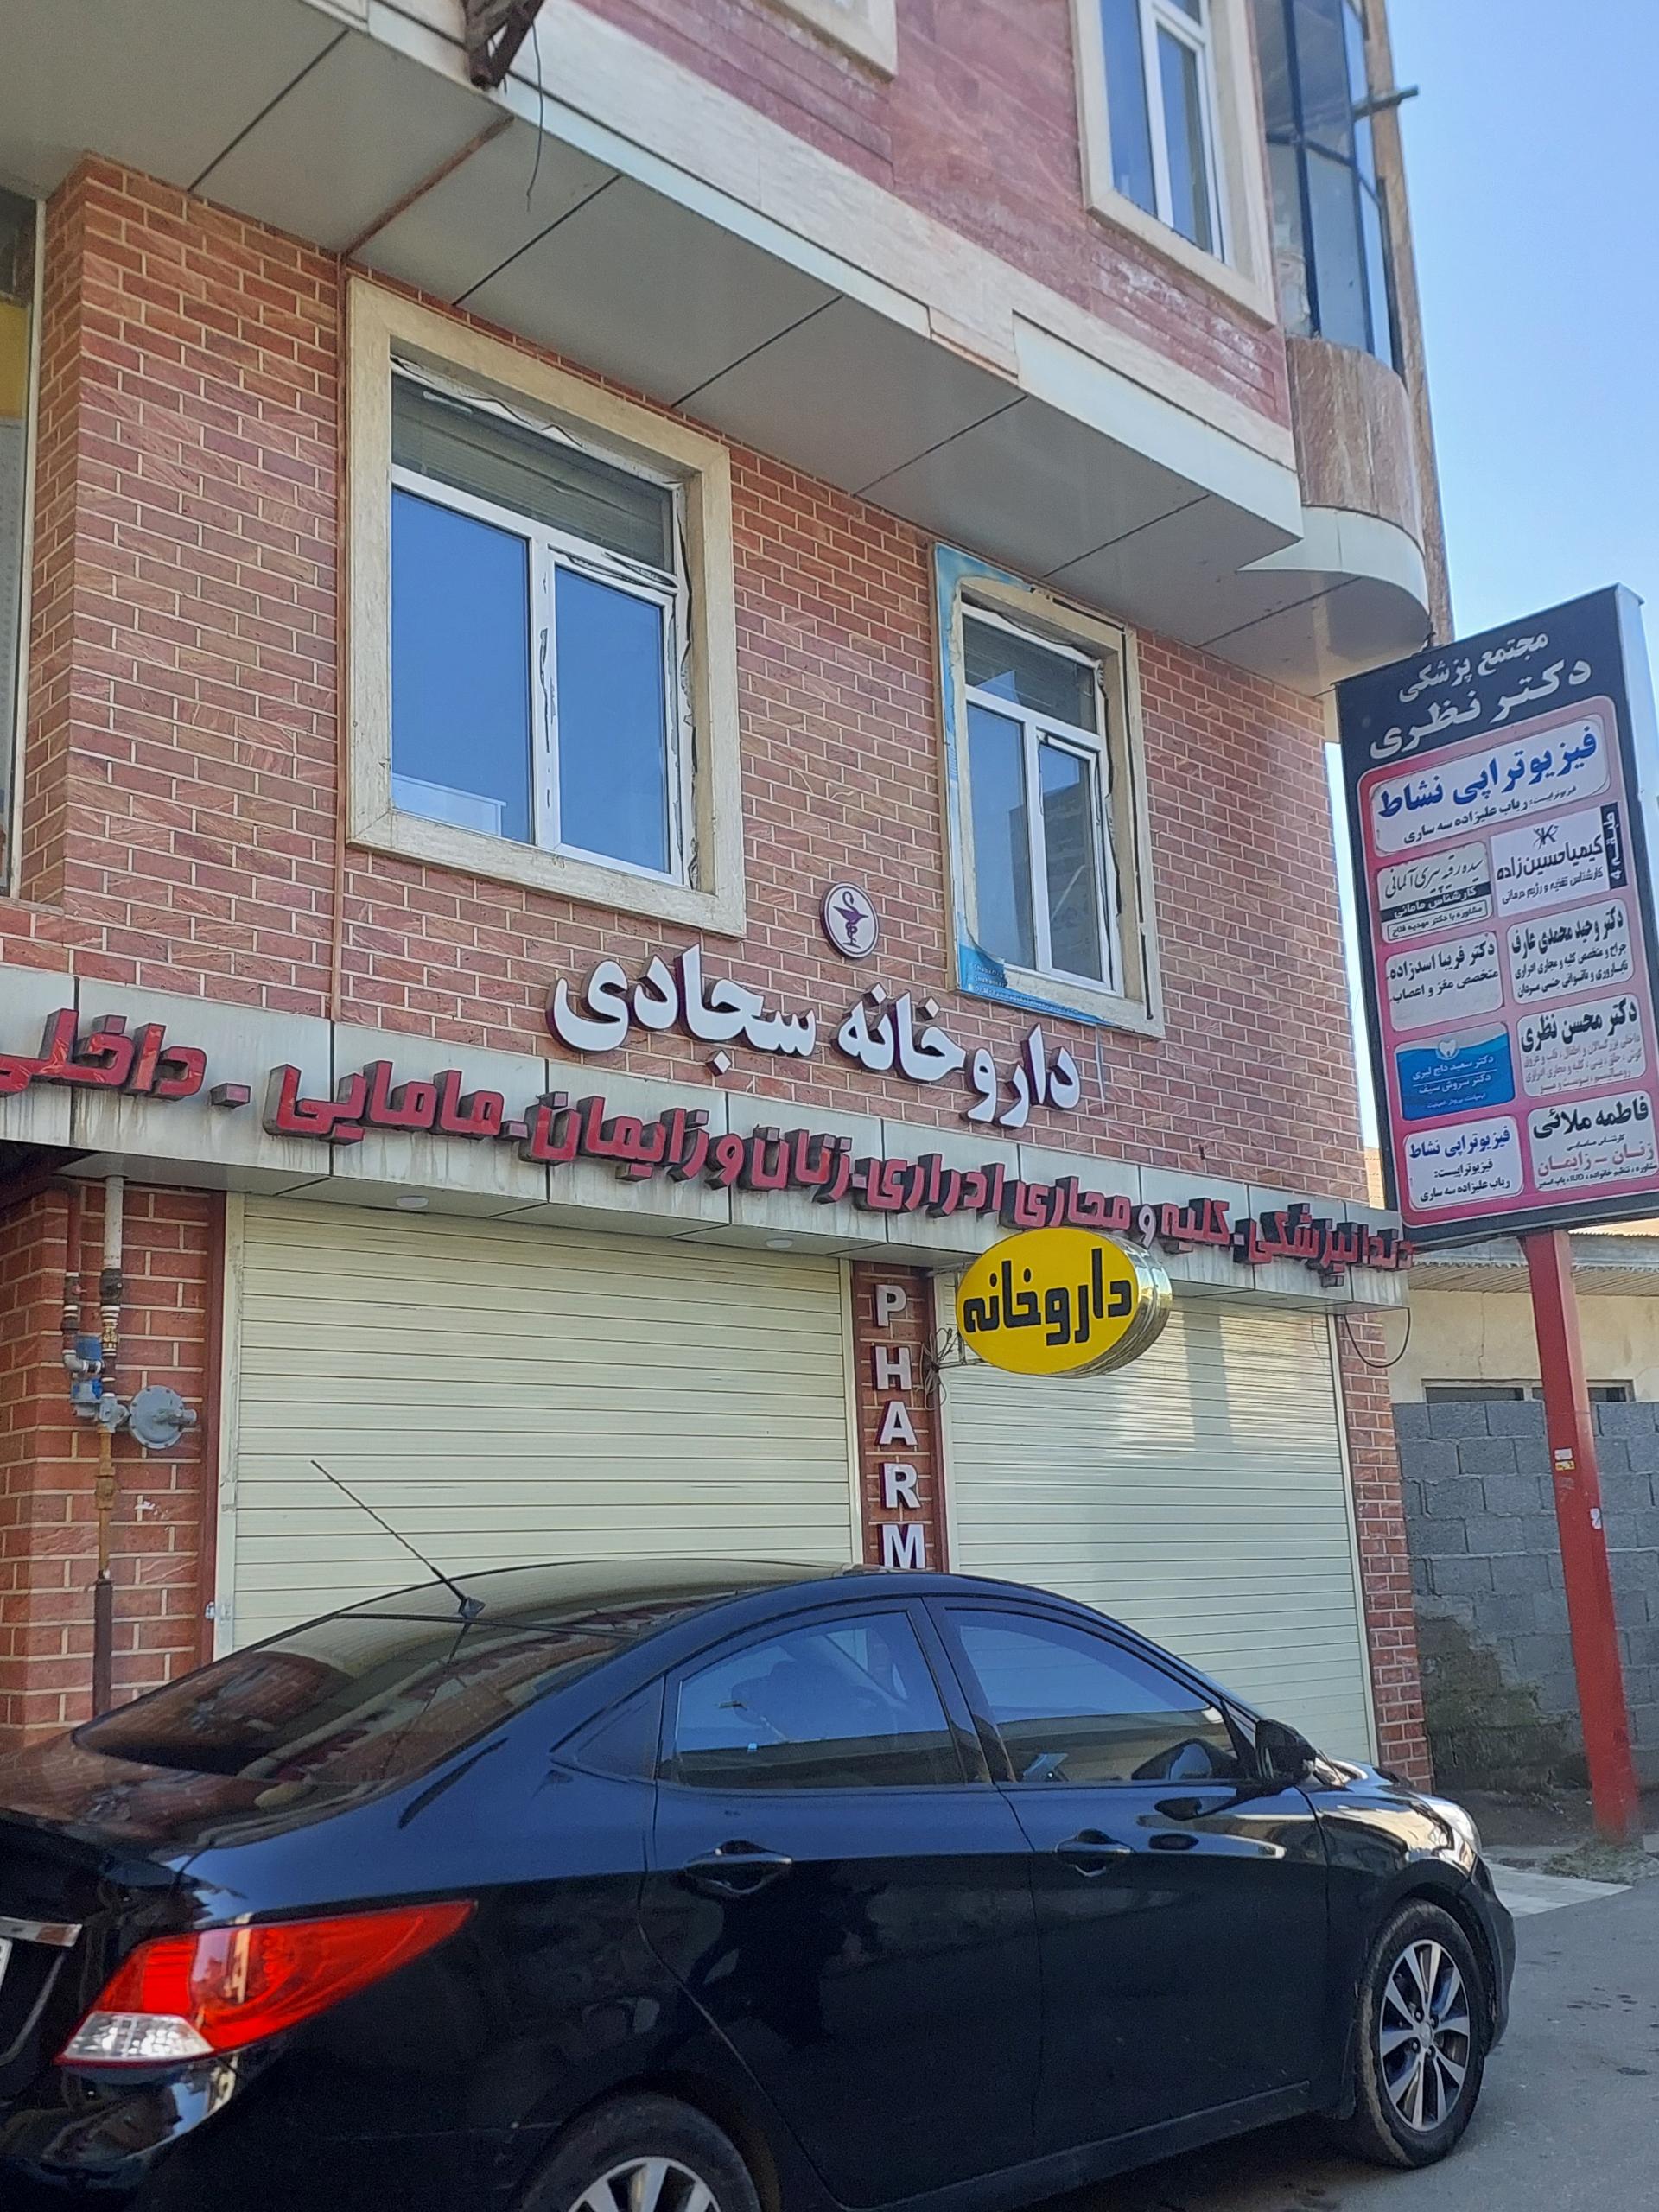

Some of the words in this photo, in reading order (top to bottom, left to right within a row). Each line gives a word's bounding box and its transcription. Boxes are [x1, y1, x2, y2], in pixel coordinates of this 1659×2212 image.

[1478, 631, 1548, 676] مجتمع
[1399, 658, 1471, 702] پزشکی
[1490, 659, 1592, 723] دکتر
[1370, 690, 1482, 760] نظری
[1452, 726, 1597, 804] فیزیوتراپی
[1378, 775, 1445, 817] نشاط
[1498, 792, 1529, 815] رباب
[1436, 821, 1453, 832] سه
[1455, 805, 1497, 827] علیزاده
[1403, 823, 1435, 845] ساری
[1565, 834, 1604, 867] کیمیا
[1569, 866, 1604, 887] کارشناس
[1427, 886, 1477, 910] کارشناس
[1431, 915, 1448, 926] دکتر
[1456, 906, 1483, 919] مشاوره
[1603, 906, 1624, 940] دکتر
[1512, 927, 1536, 959] عارف
[1538, 925, 1573, 955] محمدی
[1575, 919, 1600, 944] وحید
[1438, 944, 1465, 970] فریبا
[1469, 940, 1495, 966] دکتر
[1564, 952, 1576, 967] کلیه
[1578, 946, 1603, 964] متخصص
[1610, 942, 1626, 957] جراح
[1389, 953, 1436, 981] اسدزاده
[1456, 969, 1499, 989] متخصص
[1515, 962, 1536, 979] ادراری
[1392, 984, 1425, 1004] اعصاب
[1427, 986, 1434, 998] و
[1437, 978, 1454, 995] مغز
[1541, 977, 1560, 993] جنسی
[544, 943, 817, 1077] سجادی
[1607, 998, 1637, 1036] دکتر
[1521, 1013, 1558, 1052] نظری
[1561, 1013, 1603, 1044] محسن
[832, 982, 1082, 1128] داروخانه
[1450, 1061, 1472, 1071] سعید
[1474, 1054, 1494, 1068] دکتر
[1442, 1079, 1470, 1093] سروش
[1472, 1072, 1491, 1086] دکتر
[264, 1059, 506, 1146] مامایی
[1595, 1096, 1649, 1128] فاطمه
[1533, 1108, 1592, 1139] ملائی
[524, 1090, 710, 1184] زایمان
[1409, 1140, 1440, 1159] نشاط
[1445, 1125, 1510, 1158] فیزیوتراپی
[705, 1132, 745, 1191] و
[738, 1126, 852, 1204] زنان
[1538, 1151, 1592, 1176] زایمان
[1612, 1141, 1655, 1165] زنان
[1433, 1158, 1494, 1179] فیزیوتراپیست:
[857, 1153, 1005, 1218] ادراری
[1420, 1187, 1443, 1202] ساری
[1458, 1179, 1488, 1194] علیزاده
[1490, 1177, 1510, 1191] رباب
[1001, 1175, 1132, 1230] مجاری
[1137, 1204, 1158, 1249] و
[1162, 1197, 1230, 1255] کلیه
[1231, 1202, 1414, 1287] دندانپزشکی
[963, 1247, 1134, 1347] داروخانه
